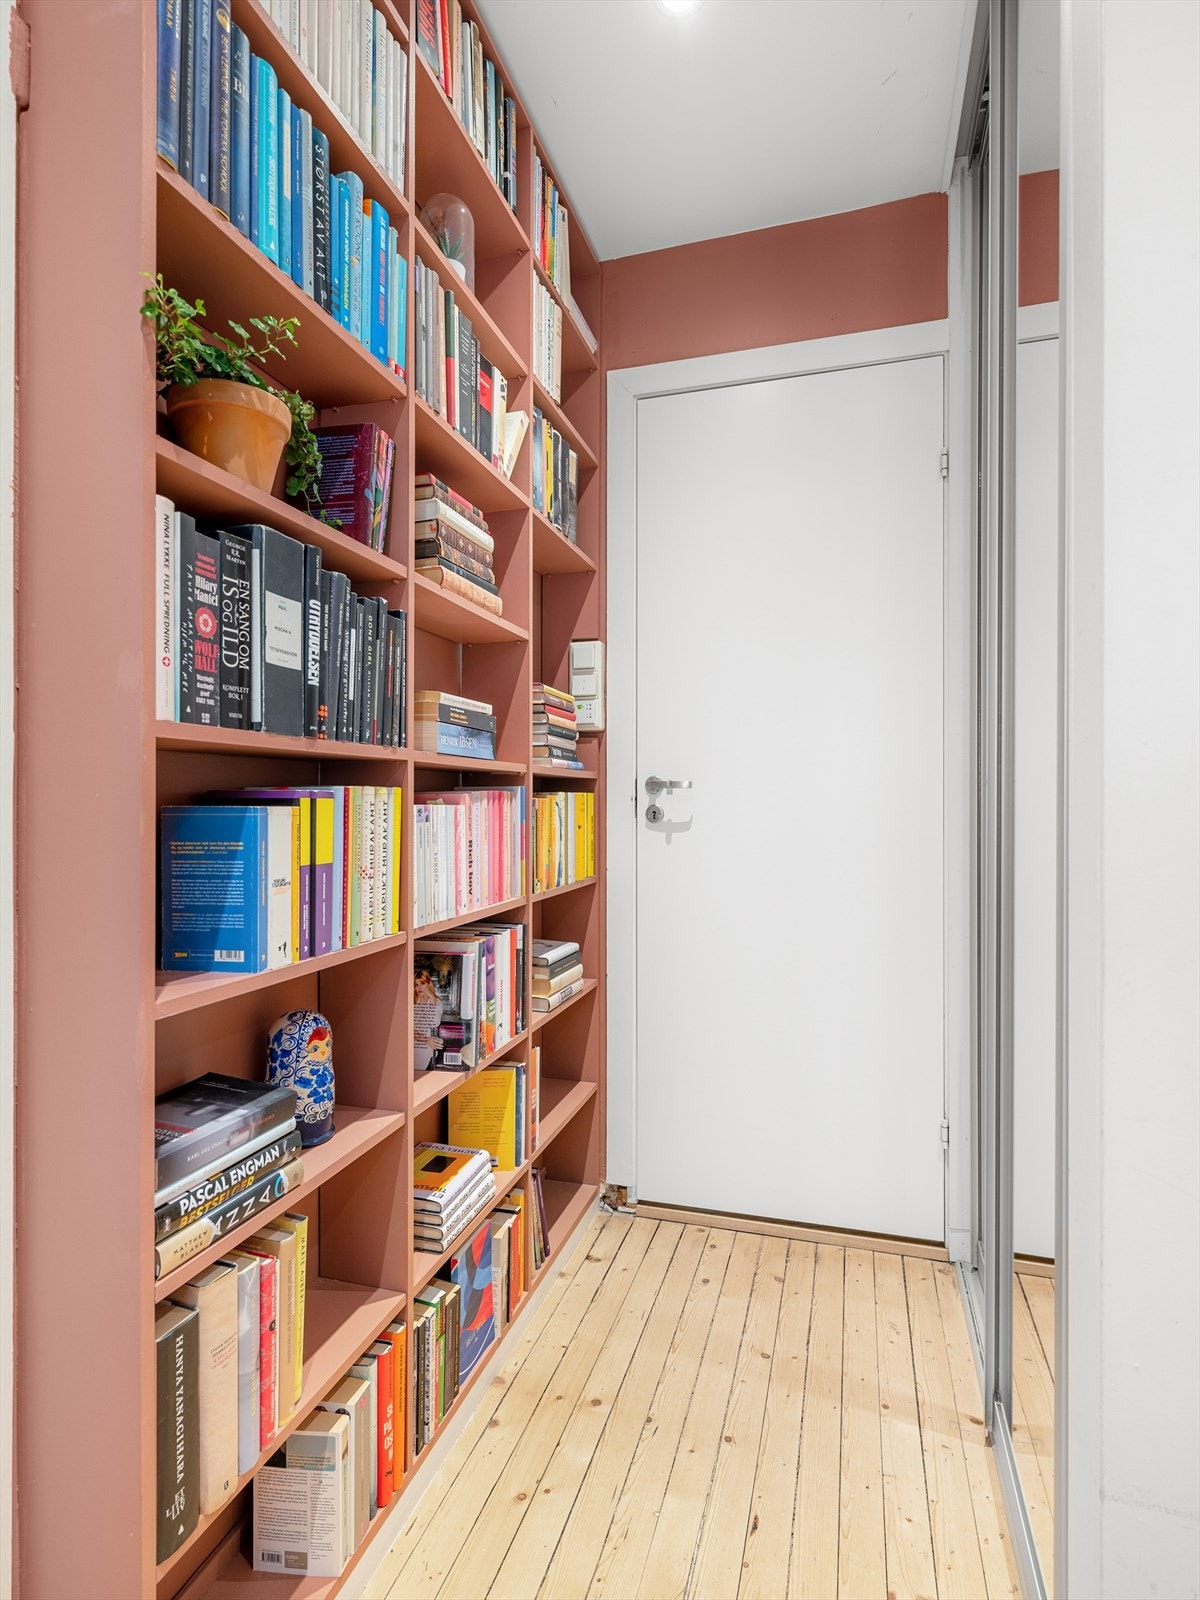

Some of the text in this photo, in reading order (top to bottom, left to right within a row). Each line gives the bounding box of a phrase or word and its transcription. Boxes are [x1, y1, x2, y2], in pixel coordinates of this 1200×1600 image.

[220, 153, 228, 194] SCHOOL
[315, 144, 325, 281] STØRST AV ALT
[225, 539, 246, 552] GEORGE
[225, 554, 246, 566] MARTIN
[195, 574, 218, 595] Hilary
[194, 588, 218, 607] Mantel
[222, 574, 239, 668] IS OG ILD
[239, 579, 250, 670] EN SANG OM
[194, 638, 219, 659] WOLF
[308, 598, 321, 686] UTRYDDELSEN
[195, 654, 218, 673] HALL
[222, 684, 250, 694] KOMPLETT
[440, 735, 477, 749] HENRIK IBSEN
[179, 1145, 280, 1217] PASCAL ENGMAN
[173, 1229, 209, 1256] MATTHEW
[180, 1241, 203, 1260] BLAKE
[176, 1334, 184, 1484] HANYA YANAGIHARA
